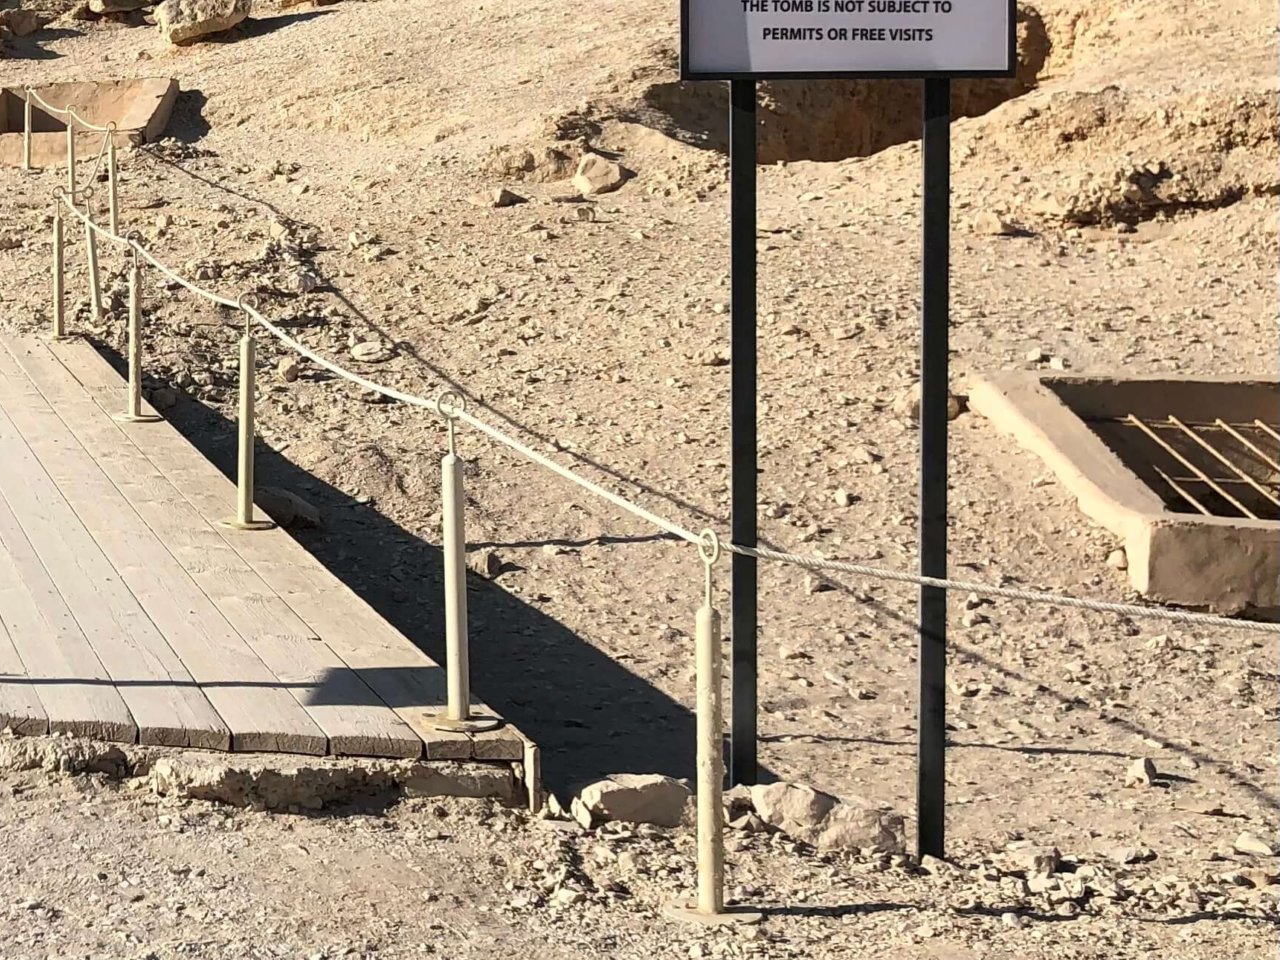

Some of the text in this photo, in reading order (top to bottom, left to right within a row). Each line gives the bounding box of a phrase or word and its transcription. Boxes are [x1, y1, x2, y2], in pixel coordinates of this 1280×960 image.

[741, 0, 953, 14] THE TOMB IS NOT SUBJECT TO
[762, 27, 934, 42] PERMITS OR FREE VISITS
